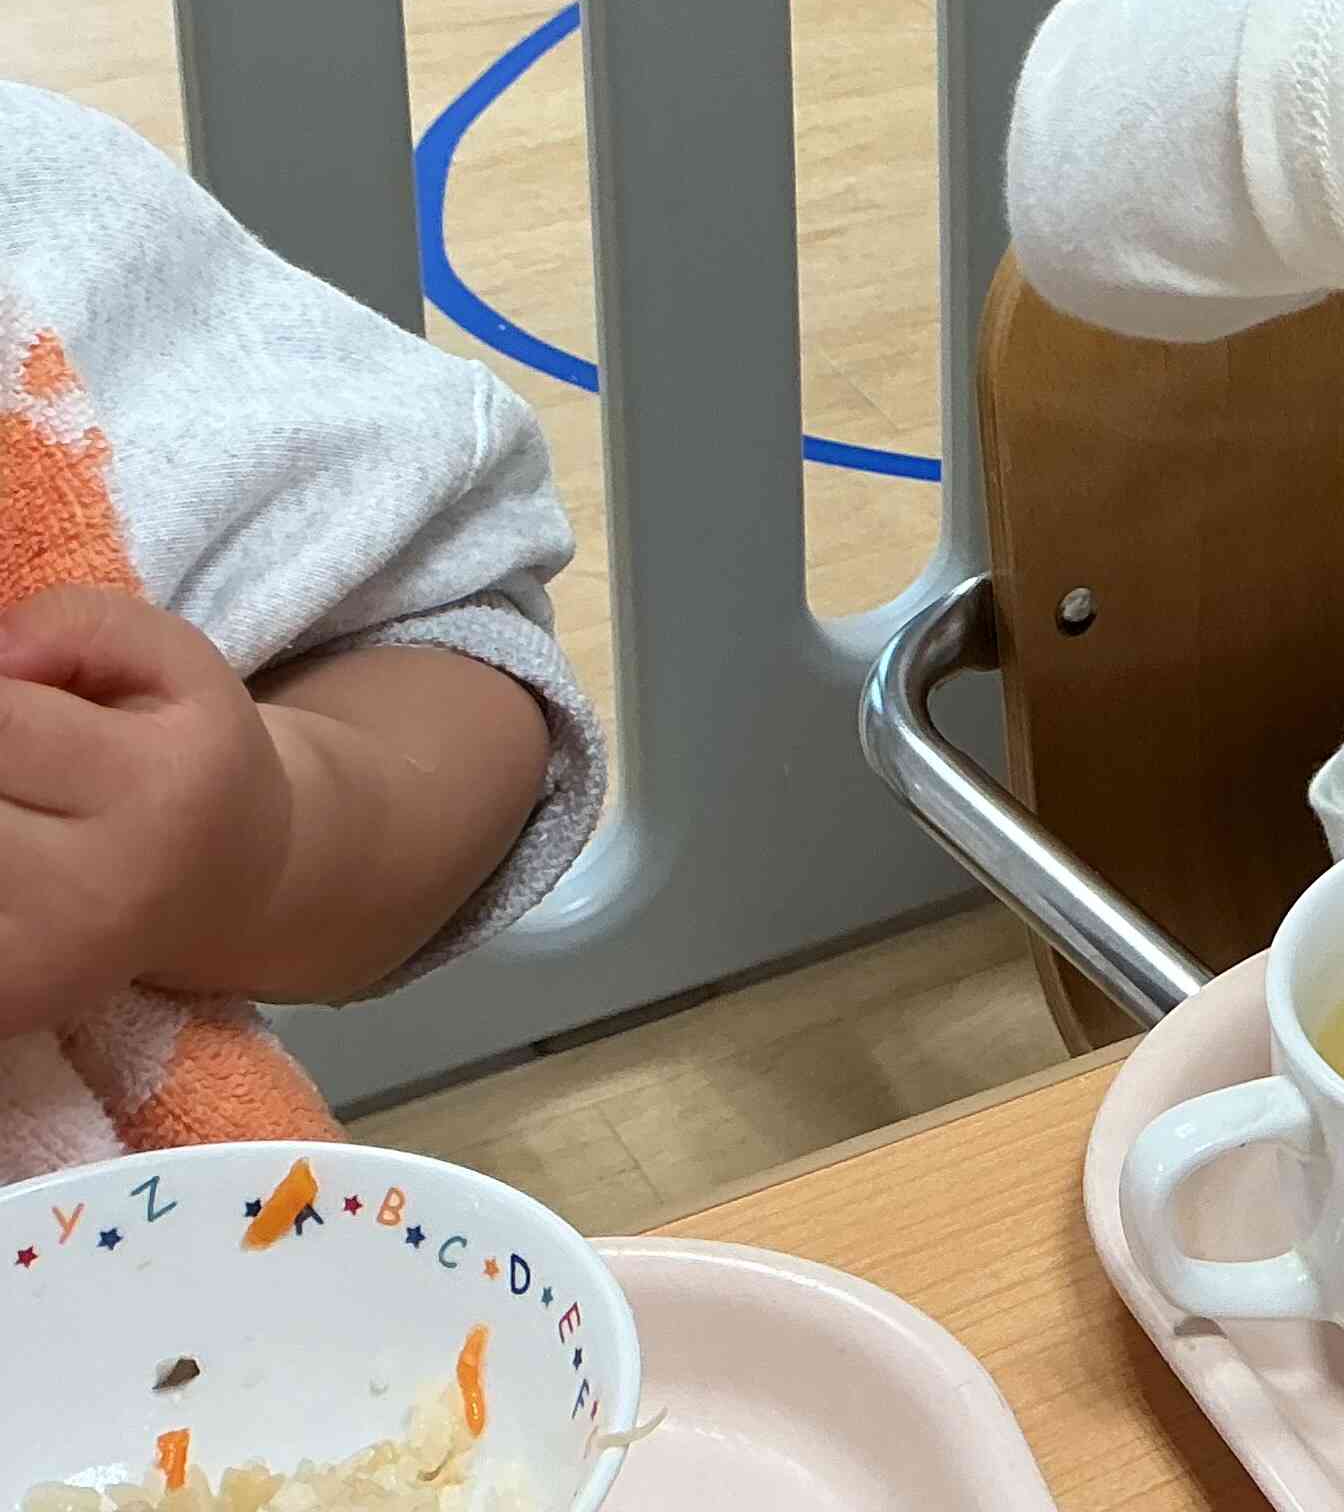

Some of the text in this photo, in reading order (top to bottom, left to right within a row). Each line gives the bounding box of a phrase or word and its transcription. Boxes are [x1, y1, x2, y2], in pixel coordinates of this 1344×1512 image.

[52, 1202, 85, 1245] Y
[129, 1175, 178, 1223] Z
[376, 1187, 406, 1226] B
[438, 1236, 468, 1268] C
[510, 1253, 531, 1295] D
[558, 1301, 581, 1344] E
[571, 1378, 590, 1420] F
